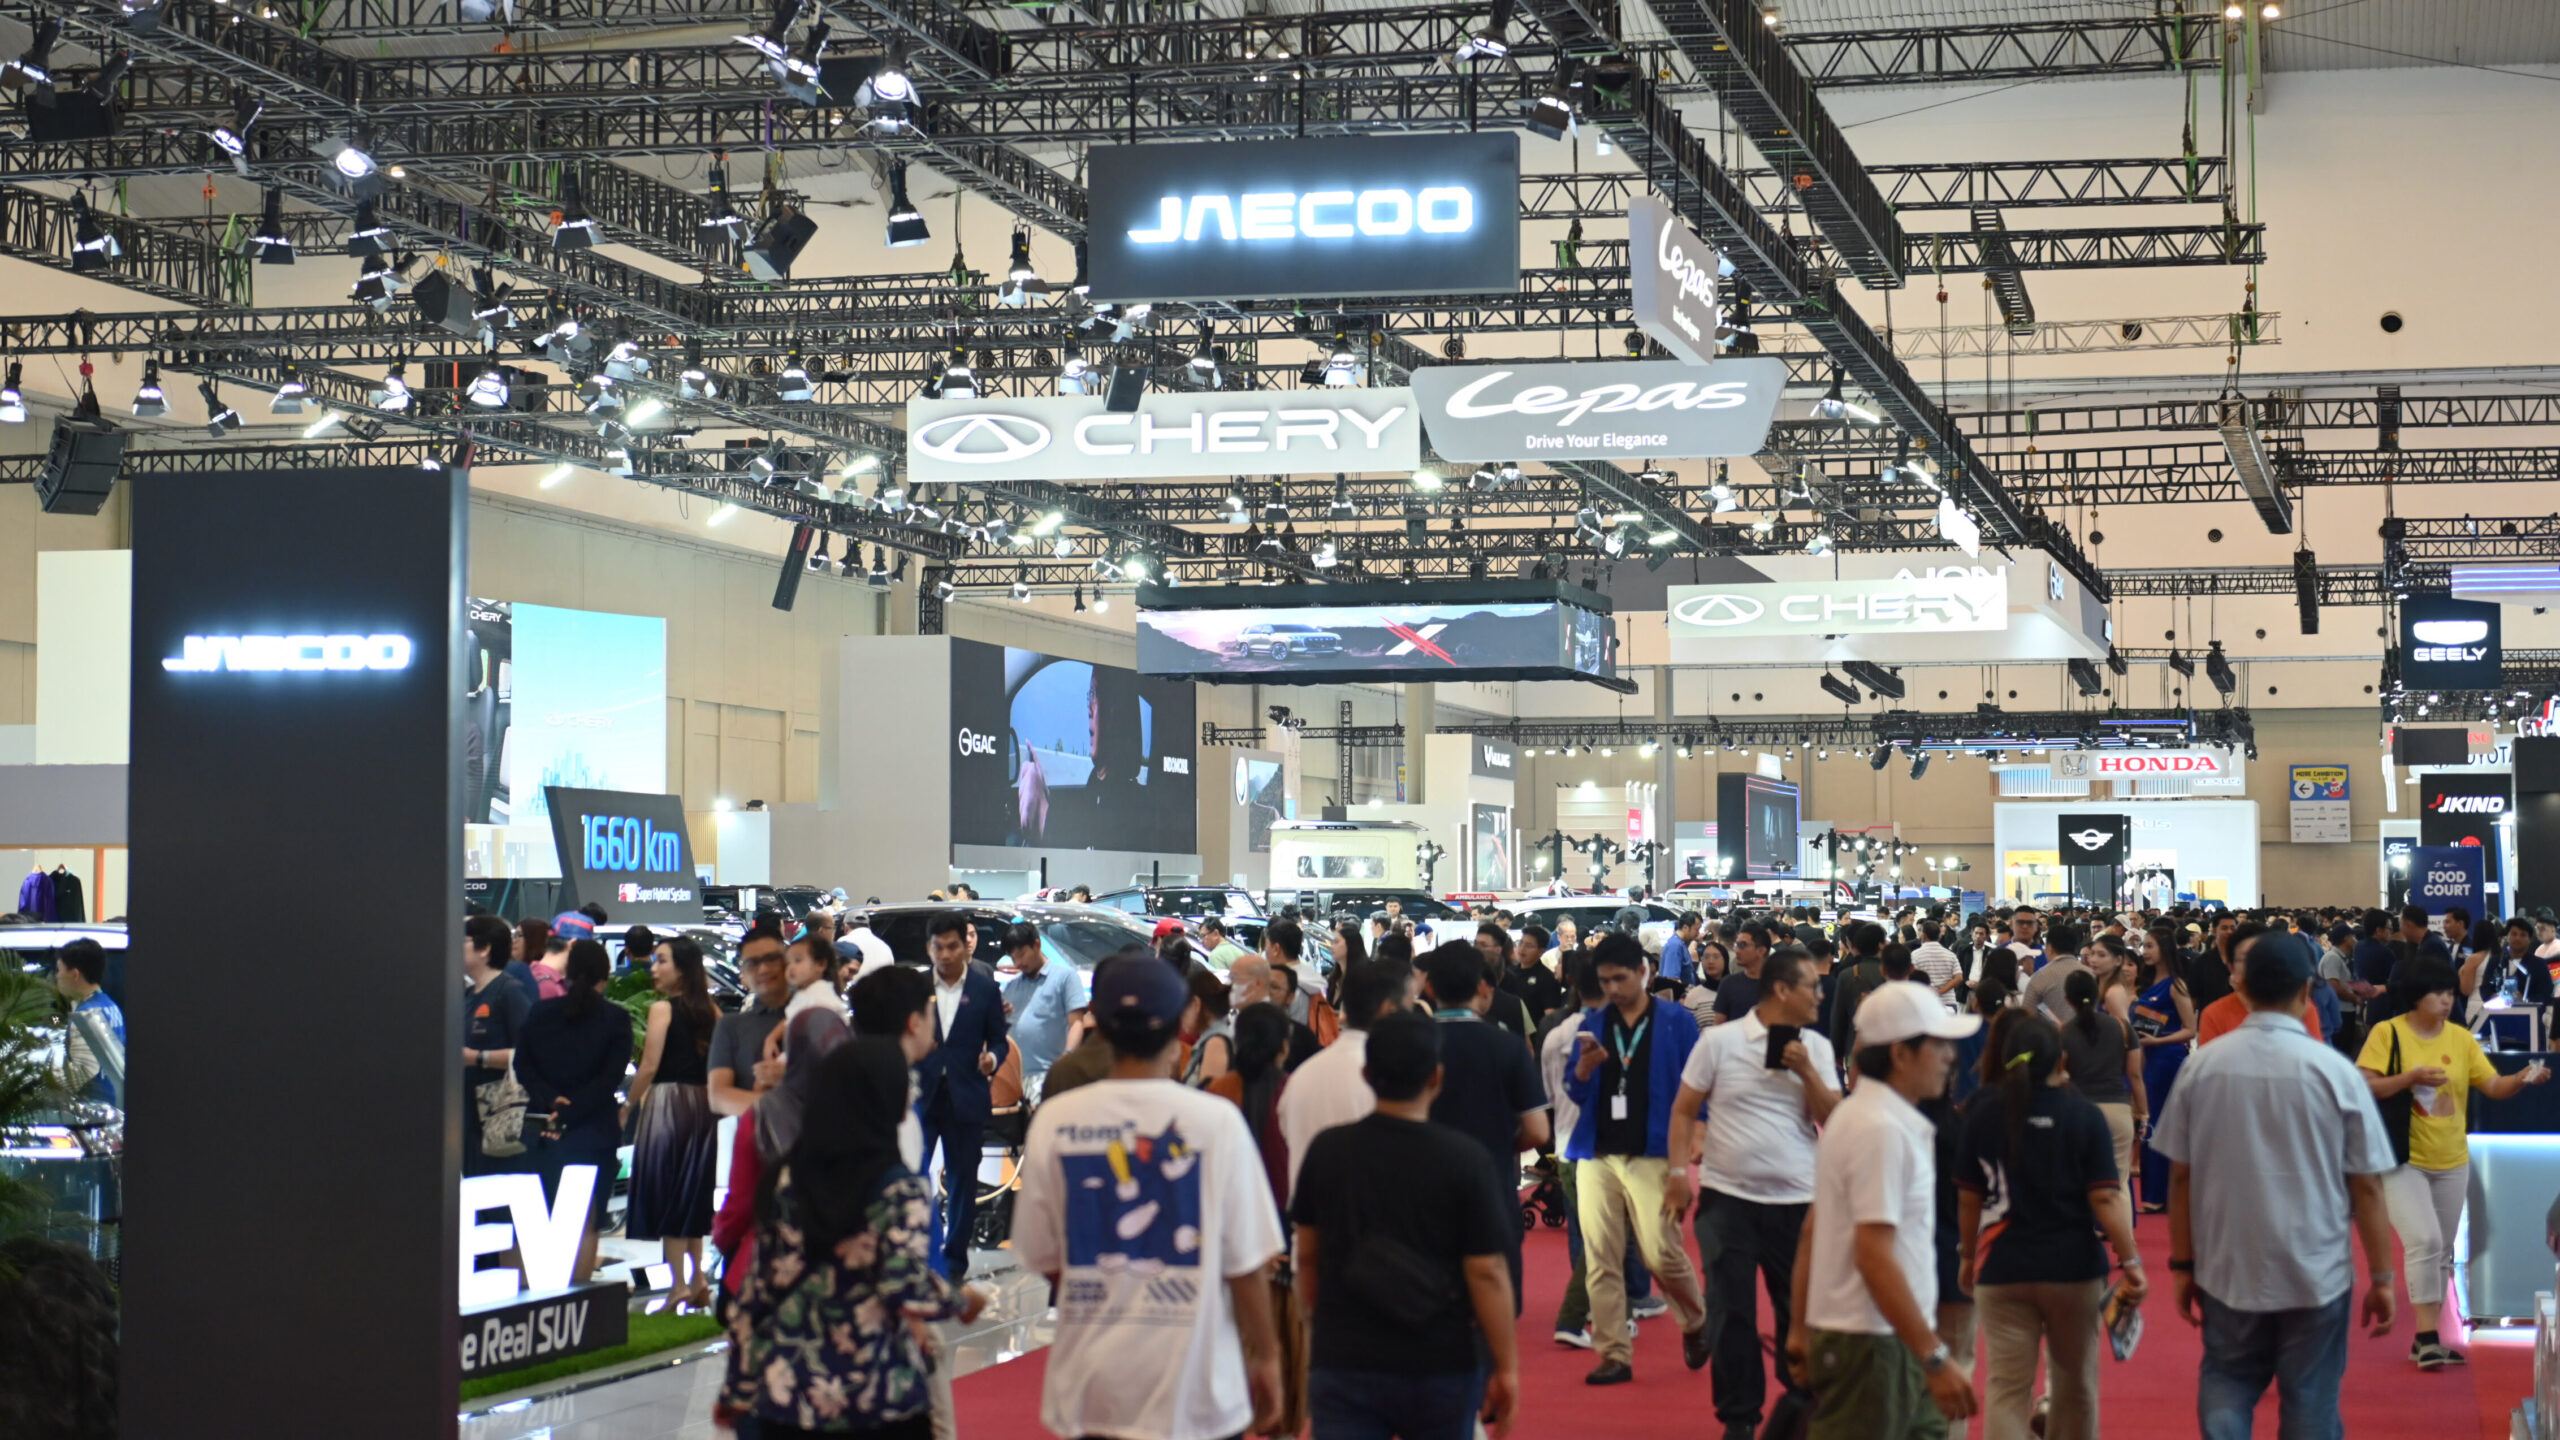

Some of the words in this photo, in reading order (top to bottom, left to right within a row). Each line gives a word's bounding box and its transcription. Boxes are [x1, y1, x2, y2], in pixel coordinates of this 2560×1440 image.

[1127, 187, 1473, 243] JAECOO
[1658, 217, 1714, 308] Lepas
[1446, 371, 1748, 426] Lepas
[1074, 407, 1406, 455] CHERY
[1526, 435, 1564, 449] Drive
[1567, 434, 1600, 448] Your
[1603, 433, 1668, 450] Elegance
[470, 610, 502, 623] CHERY
[1778, 592, 2000, 623] CHERY
[161, 634, 412, 672] JAECOO
[2413, 647, 2488, 661] GEELY
[972, 734, 997, 755] GAC
[2099, 757, 2218, 772] HONDA
[580, 814, 642, 872] 1660
[644, 818, 682, 873] km
[2423, 884, 2472, 896] COURT
[2427, 871, 2467, 883] FOOD
[480, 1309, 535, 1367] Real
[536, 1300, 590, 1354] SUV
